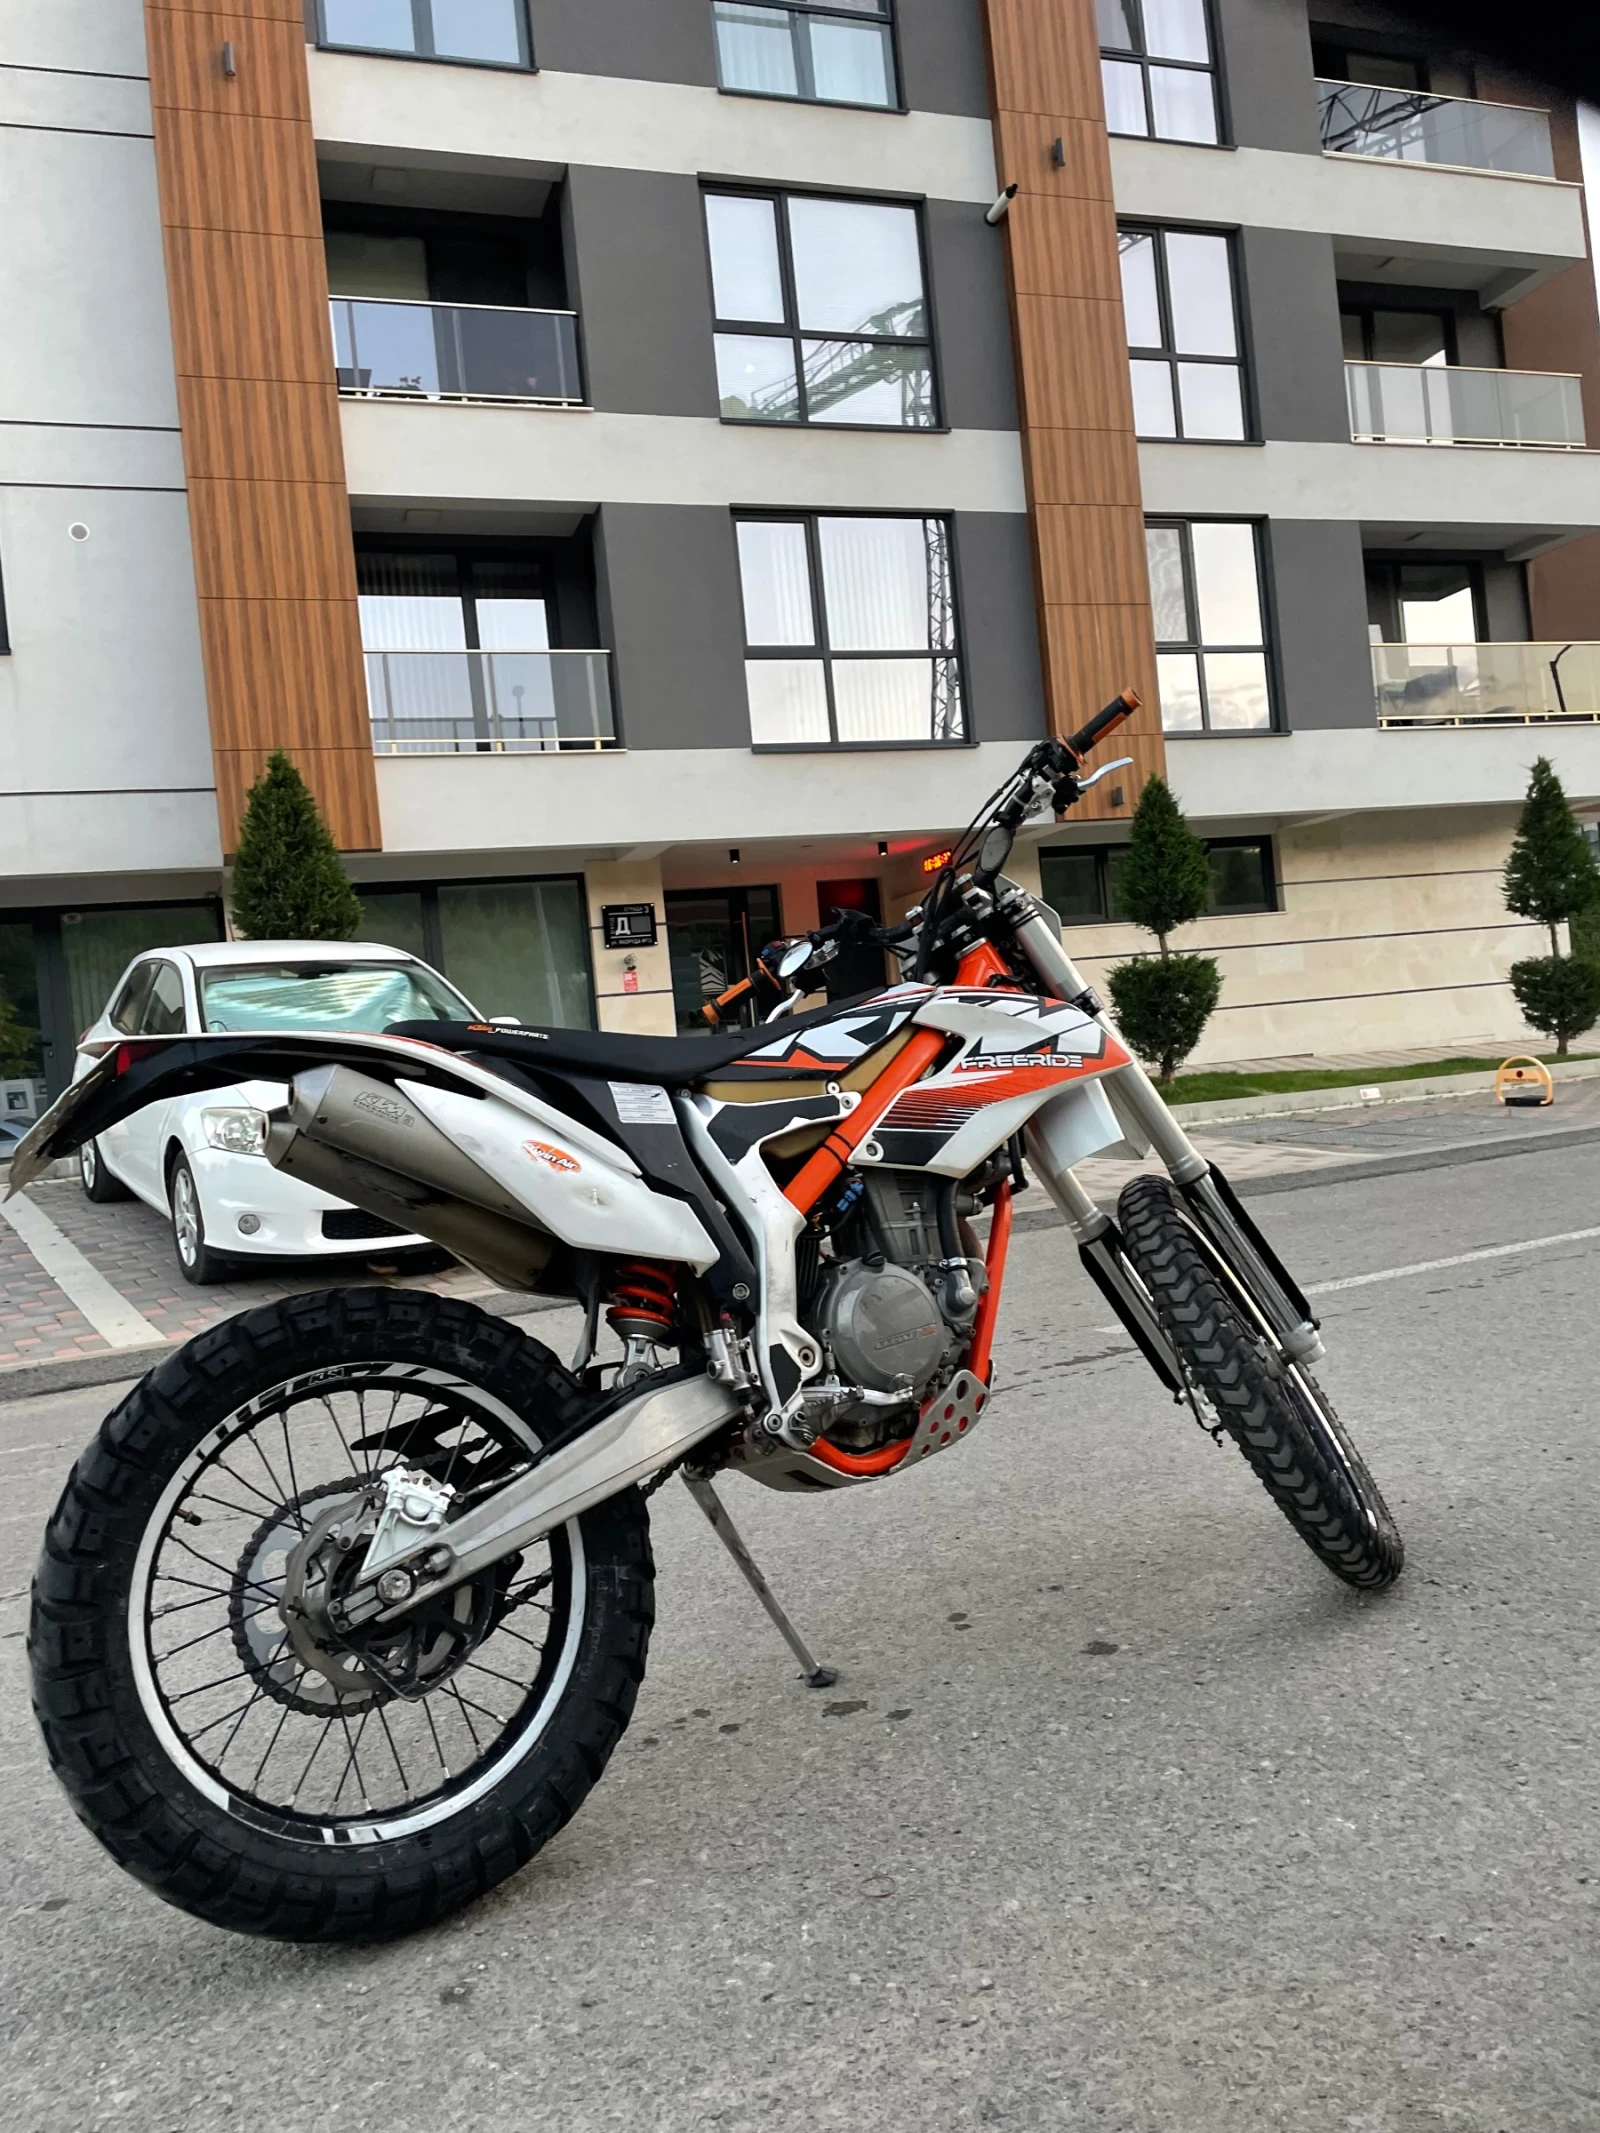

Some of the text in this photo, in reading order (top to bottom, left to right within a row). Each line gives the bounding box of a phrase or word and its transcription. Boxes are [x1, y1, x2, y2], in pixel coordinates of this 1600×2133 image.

[643, 905, 650, 914] 3
[615, 916, 631, 936] Д
[960, 1053, 1084, 1070] FREERIDE
[355, 1091, 408, 1118] KTM
[556, 1158, 577, 1170] Air
